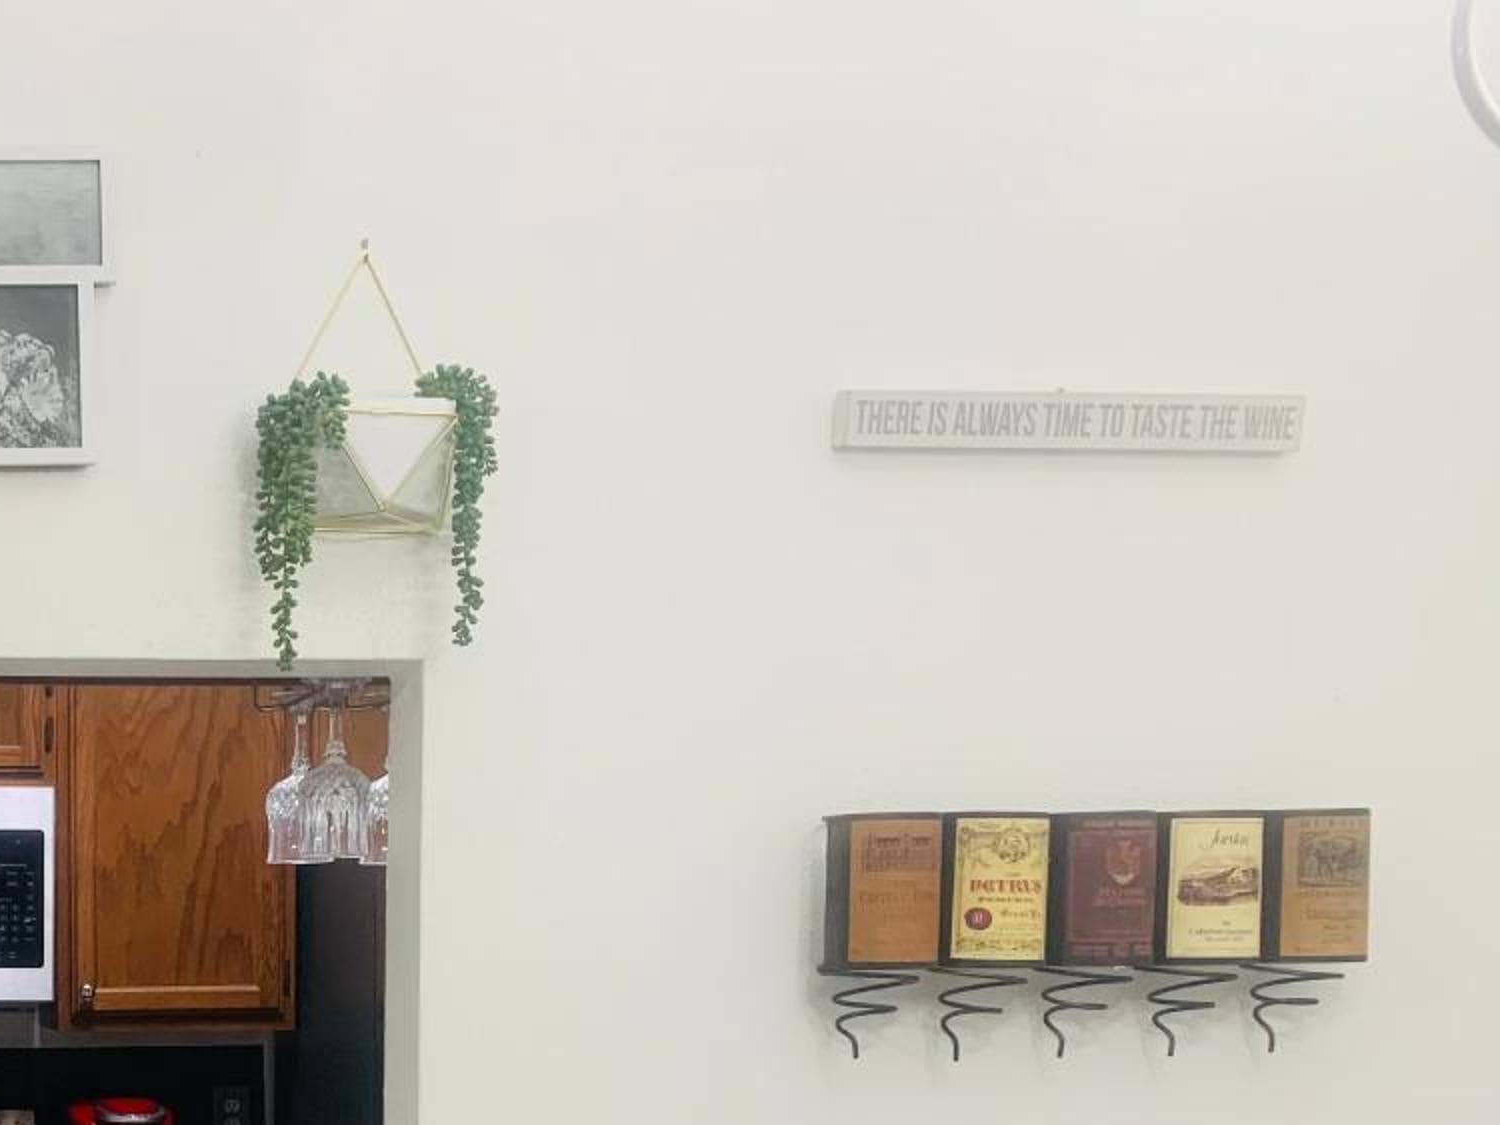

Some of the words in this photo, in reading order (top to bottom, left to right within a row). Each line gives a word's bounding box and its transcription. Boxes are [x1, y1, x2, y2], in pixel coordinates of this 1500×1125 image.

[855, 399, 923, 435] THERE
[924, 399, 950, 435] IS
[952, 400, 1040, 437] ALWAYS
[1042, 401, 1095, 438] TIME
[1097, 402, 1126, 438] TO
[1129, 403, 1195, 439] TASTE
[1199, 404, 1240, 440] THE
[1242, 404, 1300, 441] WINE
